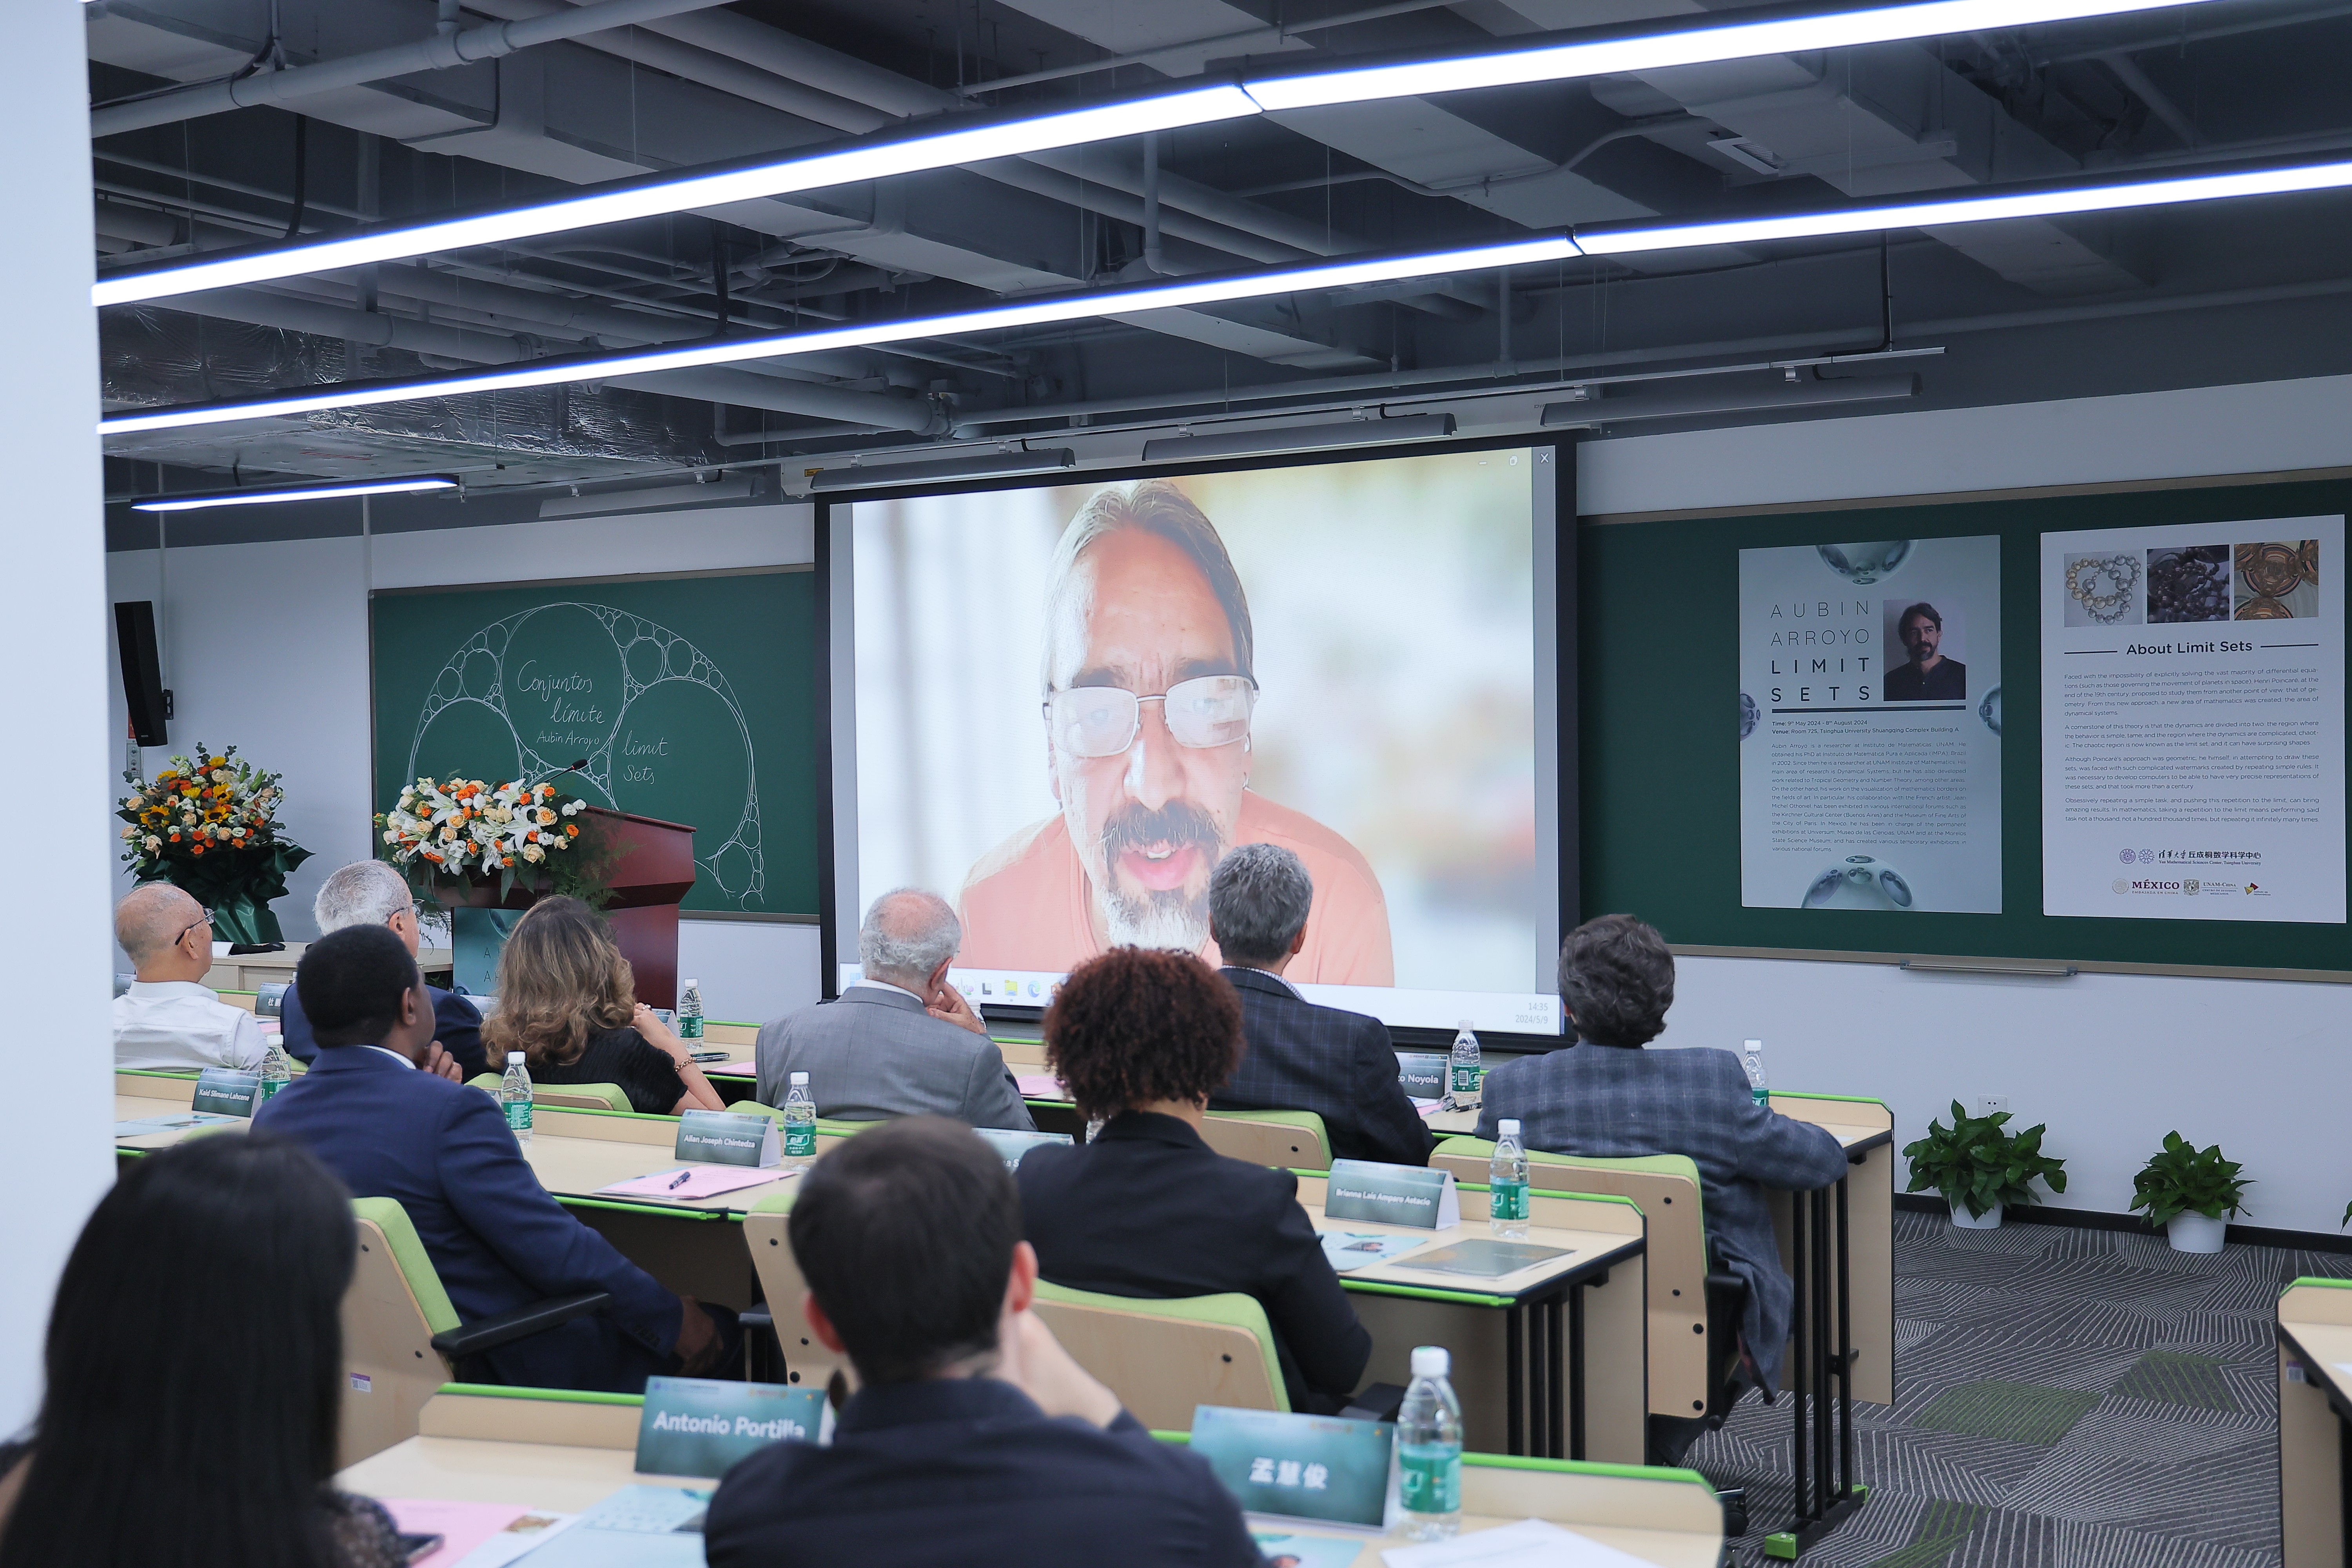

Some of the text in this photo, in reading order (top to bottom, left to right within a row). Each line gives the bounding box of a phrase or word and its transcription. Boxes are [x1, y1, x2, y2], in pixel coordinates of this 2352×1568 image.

[1771, 600, 1869, 618] AUBIN
[1771, 628, 1869, 646] ARROYO
[2126, 640, 2253, 655] About Limit Sets
[1771, 657, 1869, 674] LIMIT
[517, 660, 592, 702] Conjuntos
[1771, 685, 1869, 702] SETS
[536, 730, 599, 751] Aubin Arroyo
[623, 764, 655, 784] Sets
[2132, 879, 2180, 889] MÉXICO
[1528, 1003, 1548, 1011] 14:35
[1515, 1014, 1548, 1024] 2024/5/9
[1408, 1074, 1439, 1085] Noyola
[700, 1136, 723, 1147] Joseph
[724, 1138, 756, 1149] Chintedza
[653, 1410, 730, 1435] Antonio
